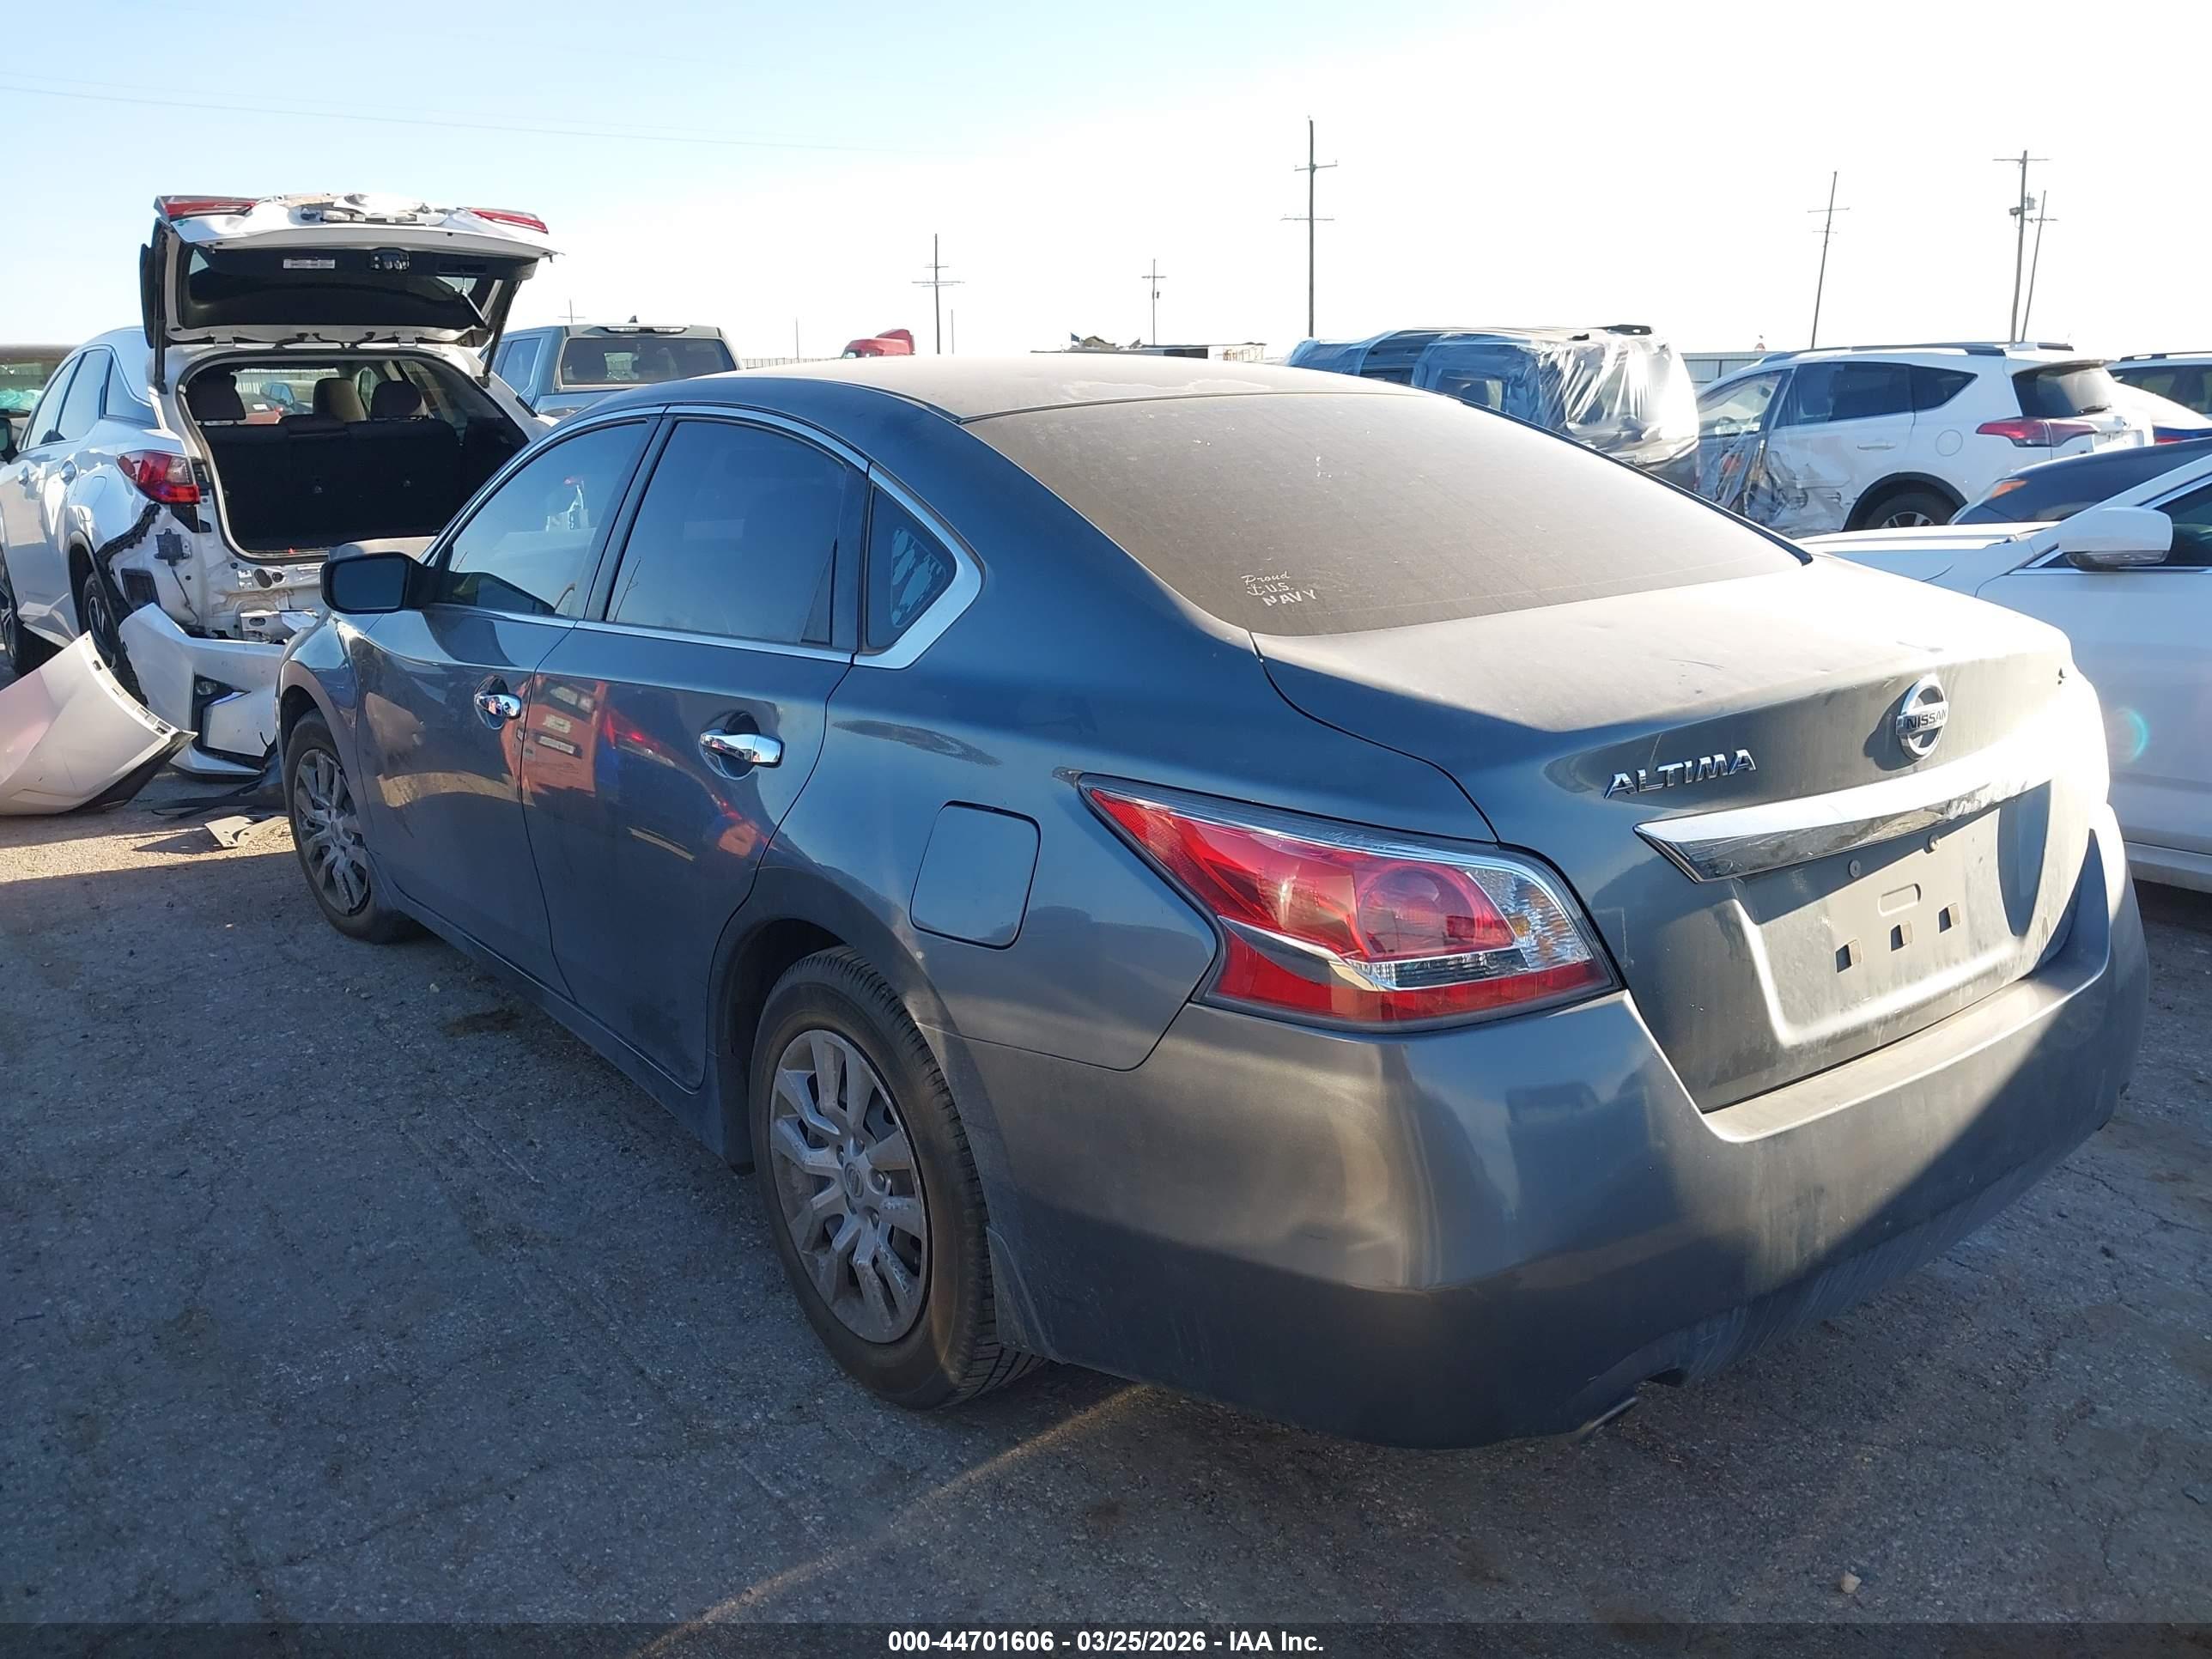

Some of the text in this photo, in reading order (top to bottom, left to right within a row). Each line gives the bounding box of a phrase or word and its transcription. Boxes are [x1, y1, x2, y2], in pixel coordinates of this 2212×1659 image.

[1241, 570, 1291, 585] Proud
[1265, 581, 1295, 593] U.S.
[1262, 589, 1317, 606] NAVY
[1905, 709, 1947, 730] NISSAN
[1603, 749, 1757, 799] ALTIMA
